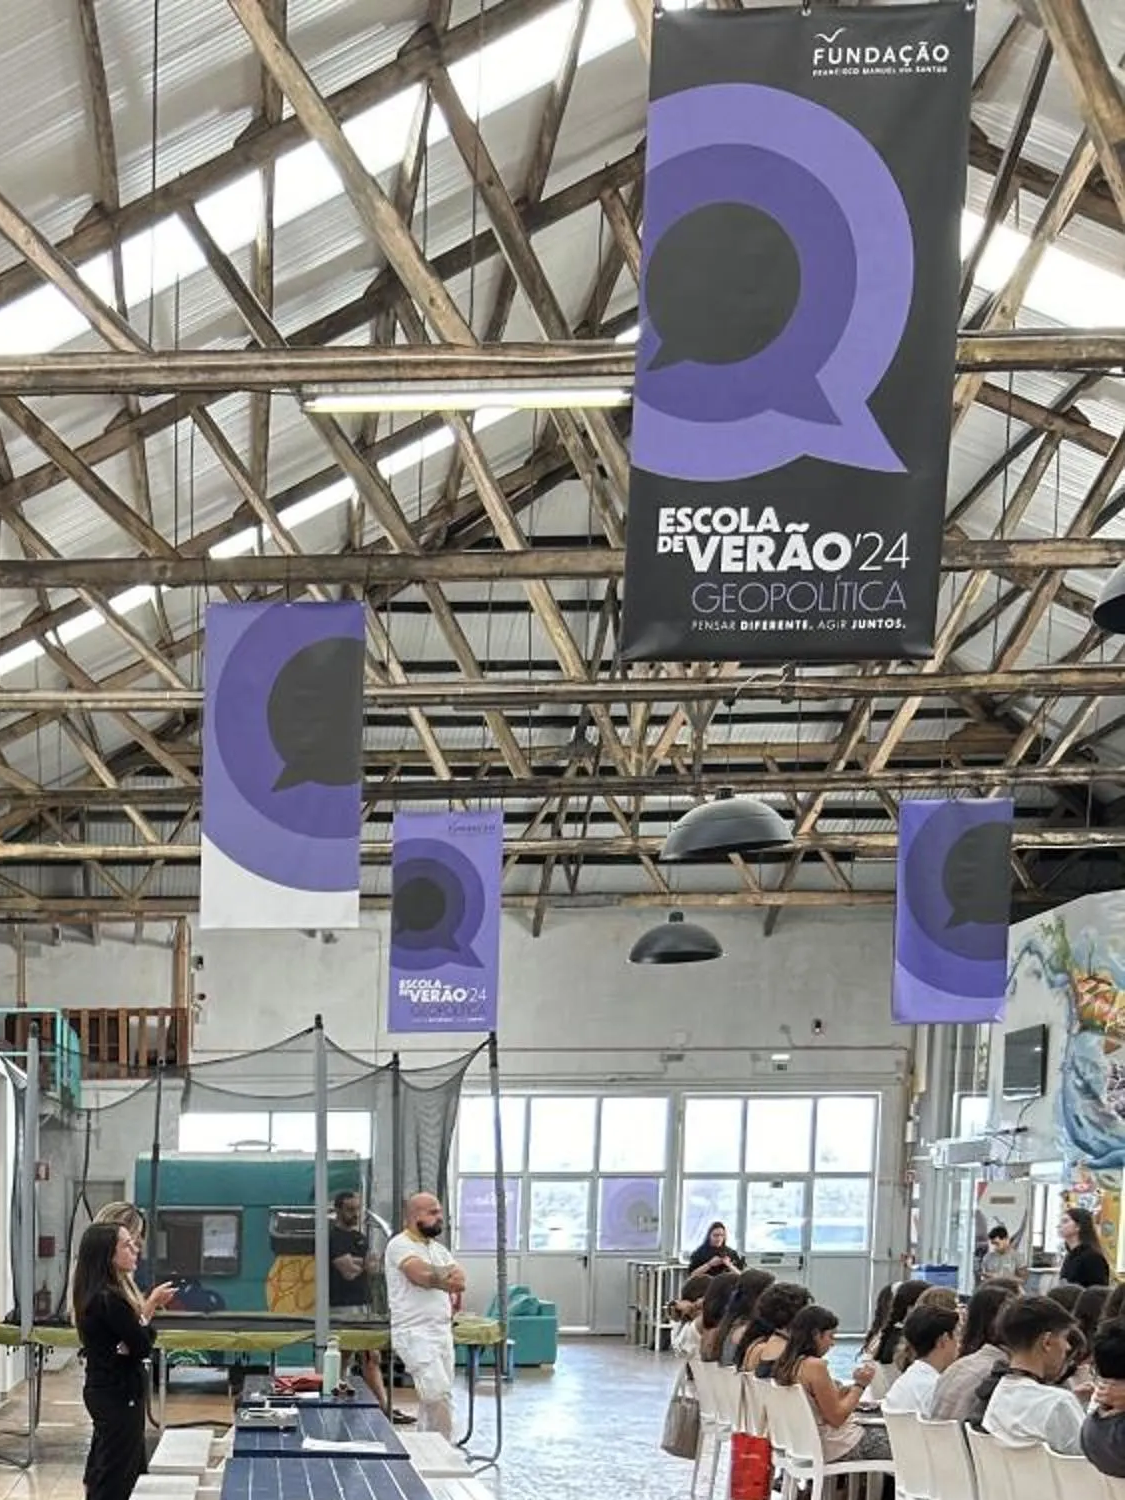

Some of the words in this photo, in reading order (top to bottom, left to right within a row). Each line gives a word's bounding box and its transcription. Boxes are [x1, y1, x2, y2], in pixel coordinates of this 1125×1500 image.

[813, 41, 950, 66] FUNDAÇÃO
[658, 506, 781, 534] ESCOLA
[657, 535, 684, 553] DE
[691, 575, 907, 613] GEOPOLÍTICA
[692, 620, 737, 631] PENSAR
[740, 619, 814, 631] DIFERENTE.
[817, 619, 848, 631] AGIR
[850, 618, 907, 630] JUNTOS.
